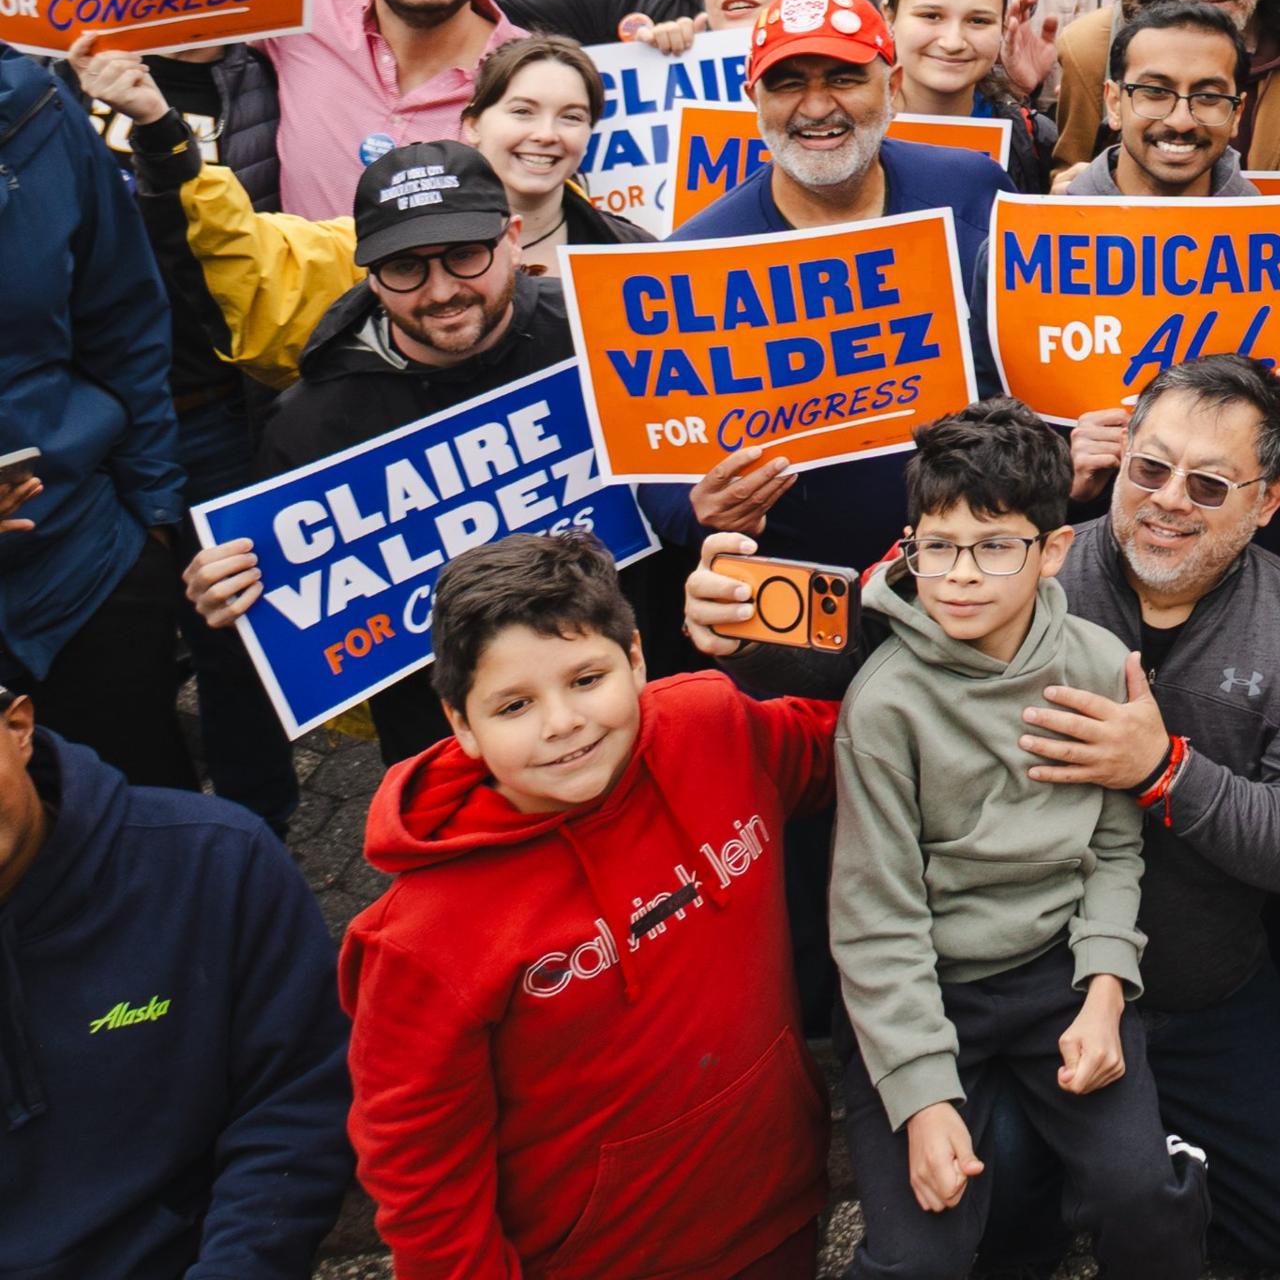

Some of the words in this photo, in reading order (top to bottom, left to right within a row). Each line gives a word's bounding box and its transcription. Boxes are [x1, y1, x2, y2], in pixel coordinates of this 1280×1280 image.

[622, 249, 900, 336] CLAIRE
[606, 313, 940, 397] VALDEZ
[1038, 316, 1122, 364] FOR
[646, 415, 708, 451] FOR
[273, 400, 562, 565] CLAIRE
[264, 448, 603, 630] VALDEZ
[323, 612, 396, 676] FOR
[89, 995, 172, 1034] Alaska
